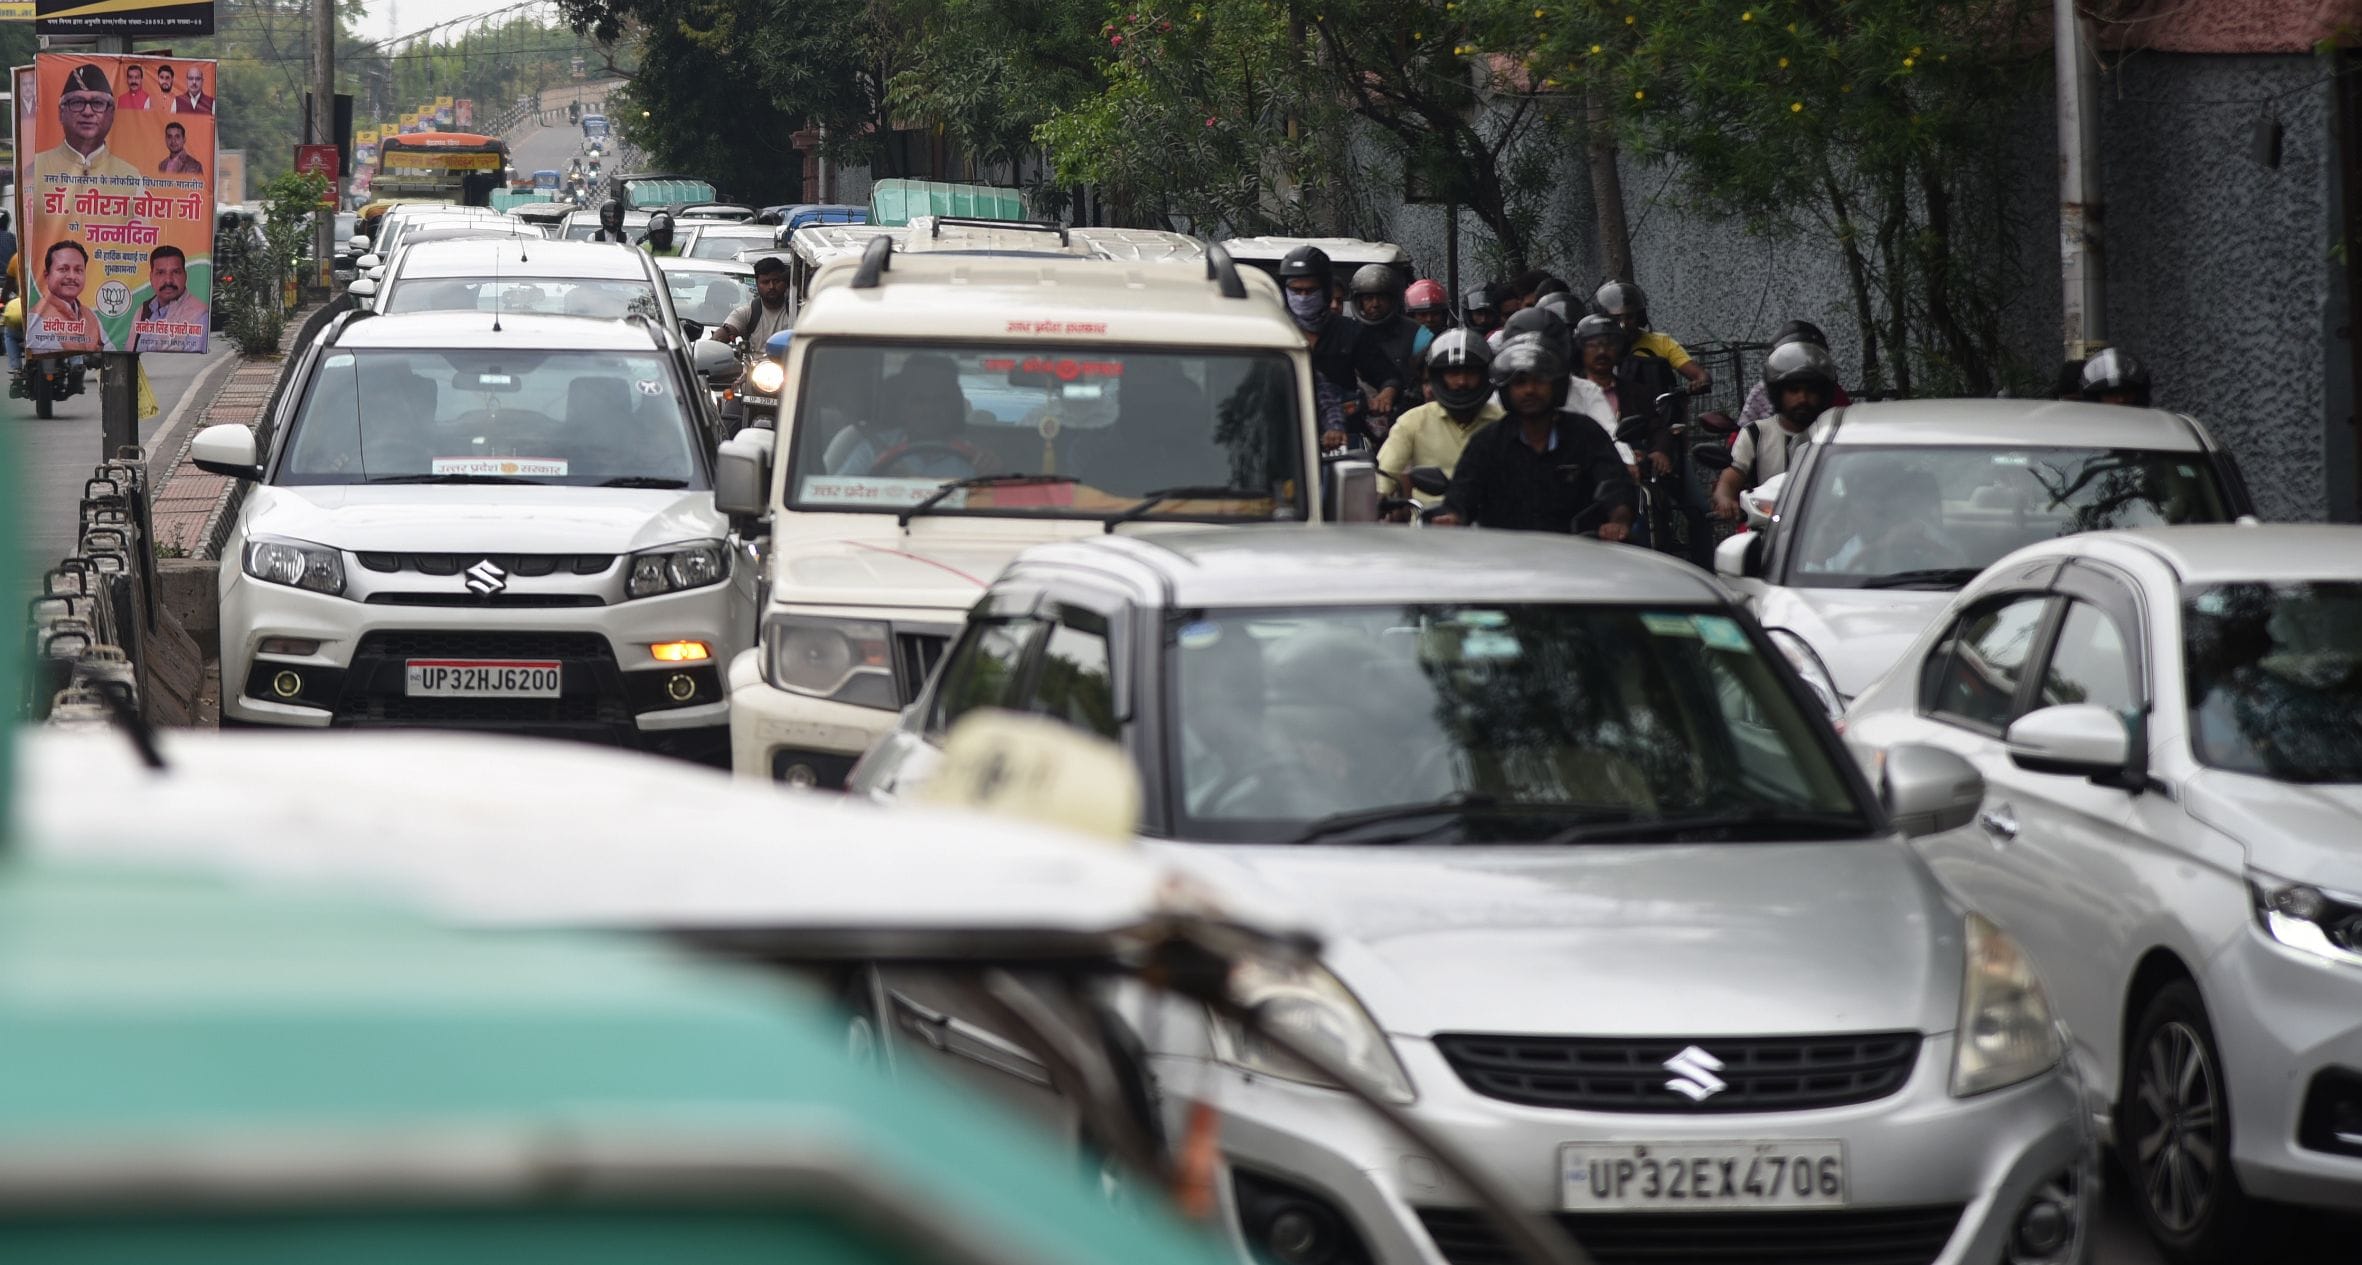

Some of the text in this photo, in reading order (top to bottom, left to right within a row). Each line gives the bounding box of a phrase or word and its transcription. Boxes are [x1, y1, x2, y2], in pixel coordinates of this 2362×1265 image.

[44, 174, 58, 183] उत्तर
[100, 174, 107, 184] के
[110, 175, 139, 187] लोकप्रिय
[44, 187, 70, 214] डॉ.
[75, 188, 130, 217] नीरज
[133, 190, 174, 219] बोरा
[176, 192, 202, 220] जी
[68, 221, 159, 245] को जन्मदिन
[94, 248, 102, 259] की
[43, 318, 85, 333] संदीप वर्मा
[135, 319, 154, 333] मनोज
[156, 320, 168, 334] सिंह
[170, 320, 188, 338] पुजारी
[470, 461, 498, 473] प्रदेश
[521, 464, 560, 475] सरकार
[422, 667, 558, 691] UP32HJ6200
[1589, 1155, 1838, 1198] UP32EX4706
